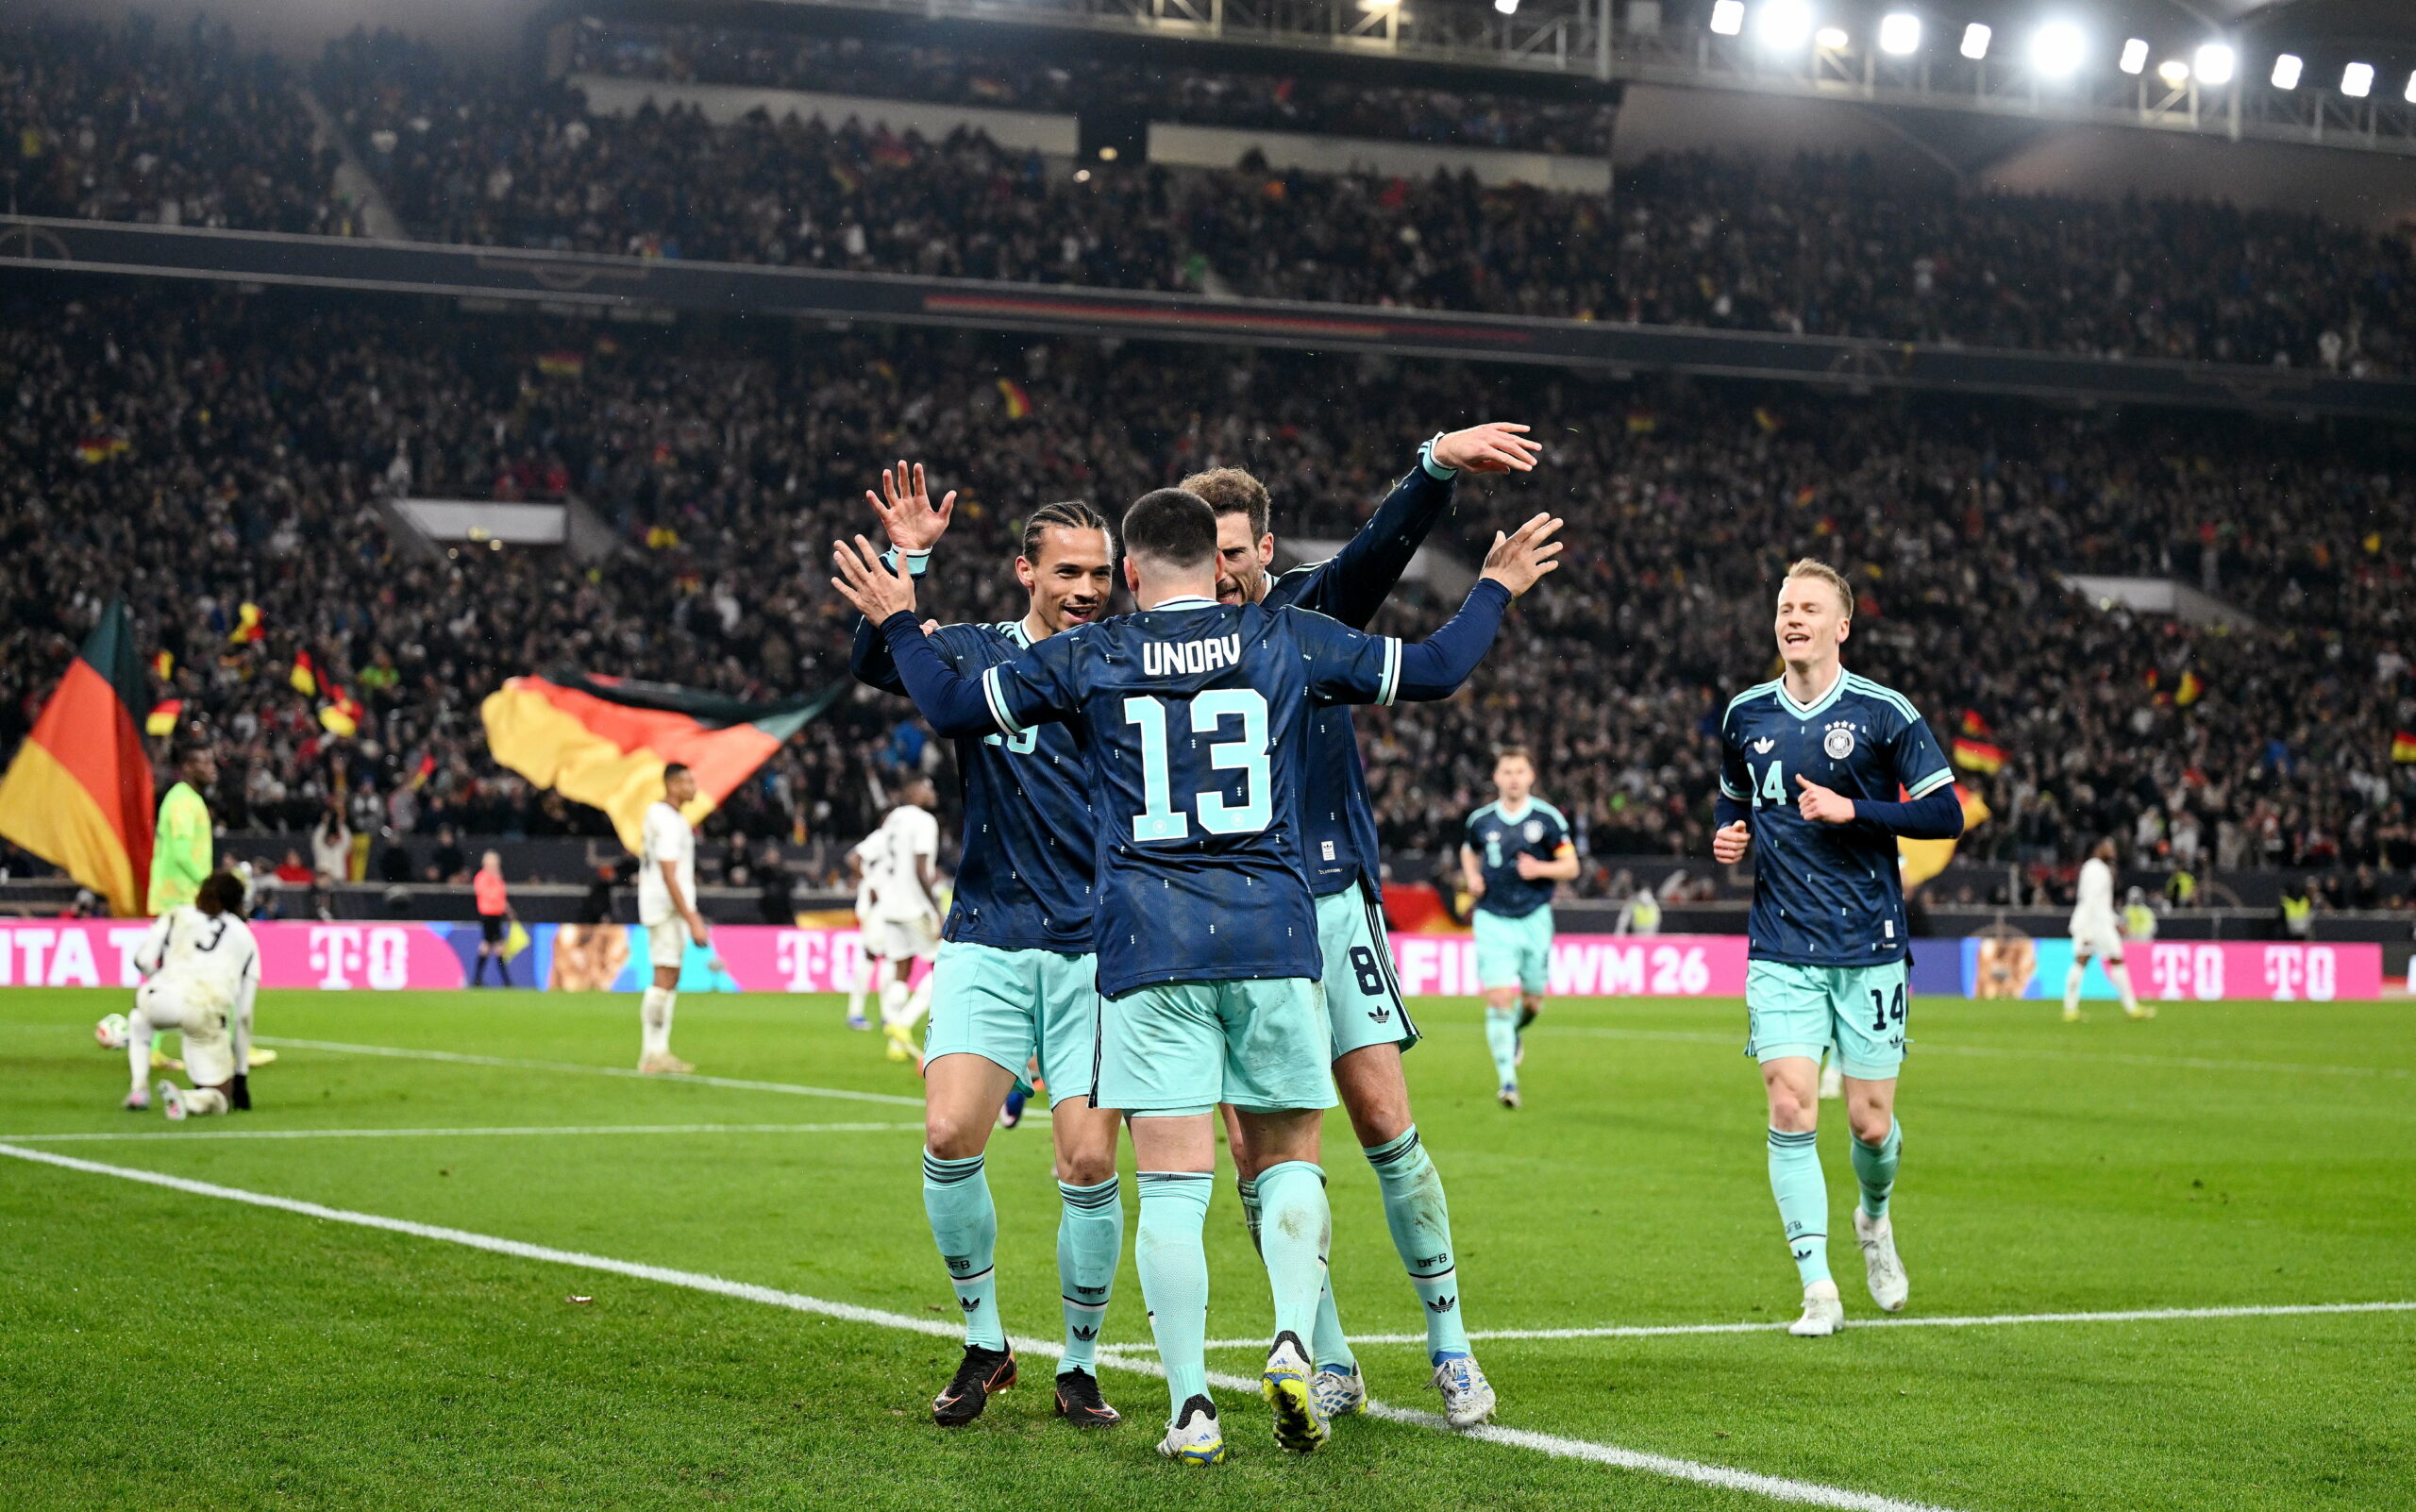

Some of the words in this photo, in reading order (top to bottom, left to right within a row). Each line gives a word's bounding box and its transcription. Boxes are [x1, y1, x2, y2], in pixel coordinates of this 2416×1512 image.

[1143, 633, 1241, 676] UNDAV
[1123, 688, 1273, 842] 13
[194, 919, 226, 952] 3
[1349, 946, 1384, 997] 8
[1549, 945, 1645, 996] WM
[1652, 946, 1710, 994] 26
[1871, 983, 1904, 1031] 14
[1417, 1252, 1448, 1268] DFB
